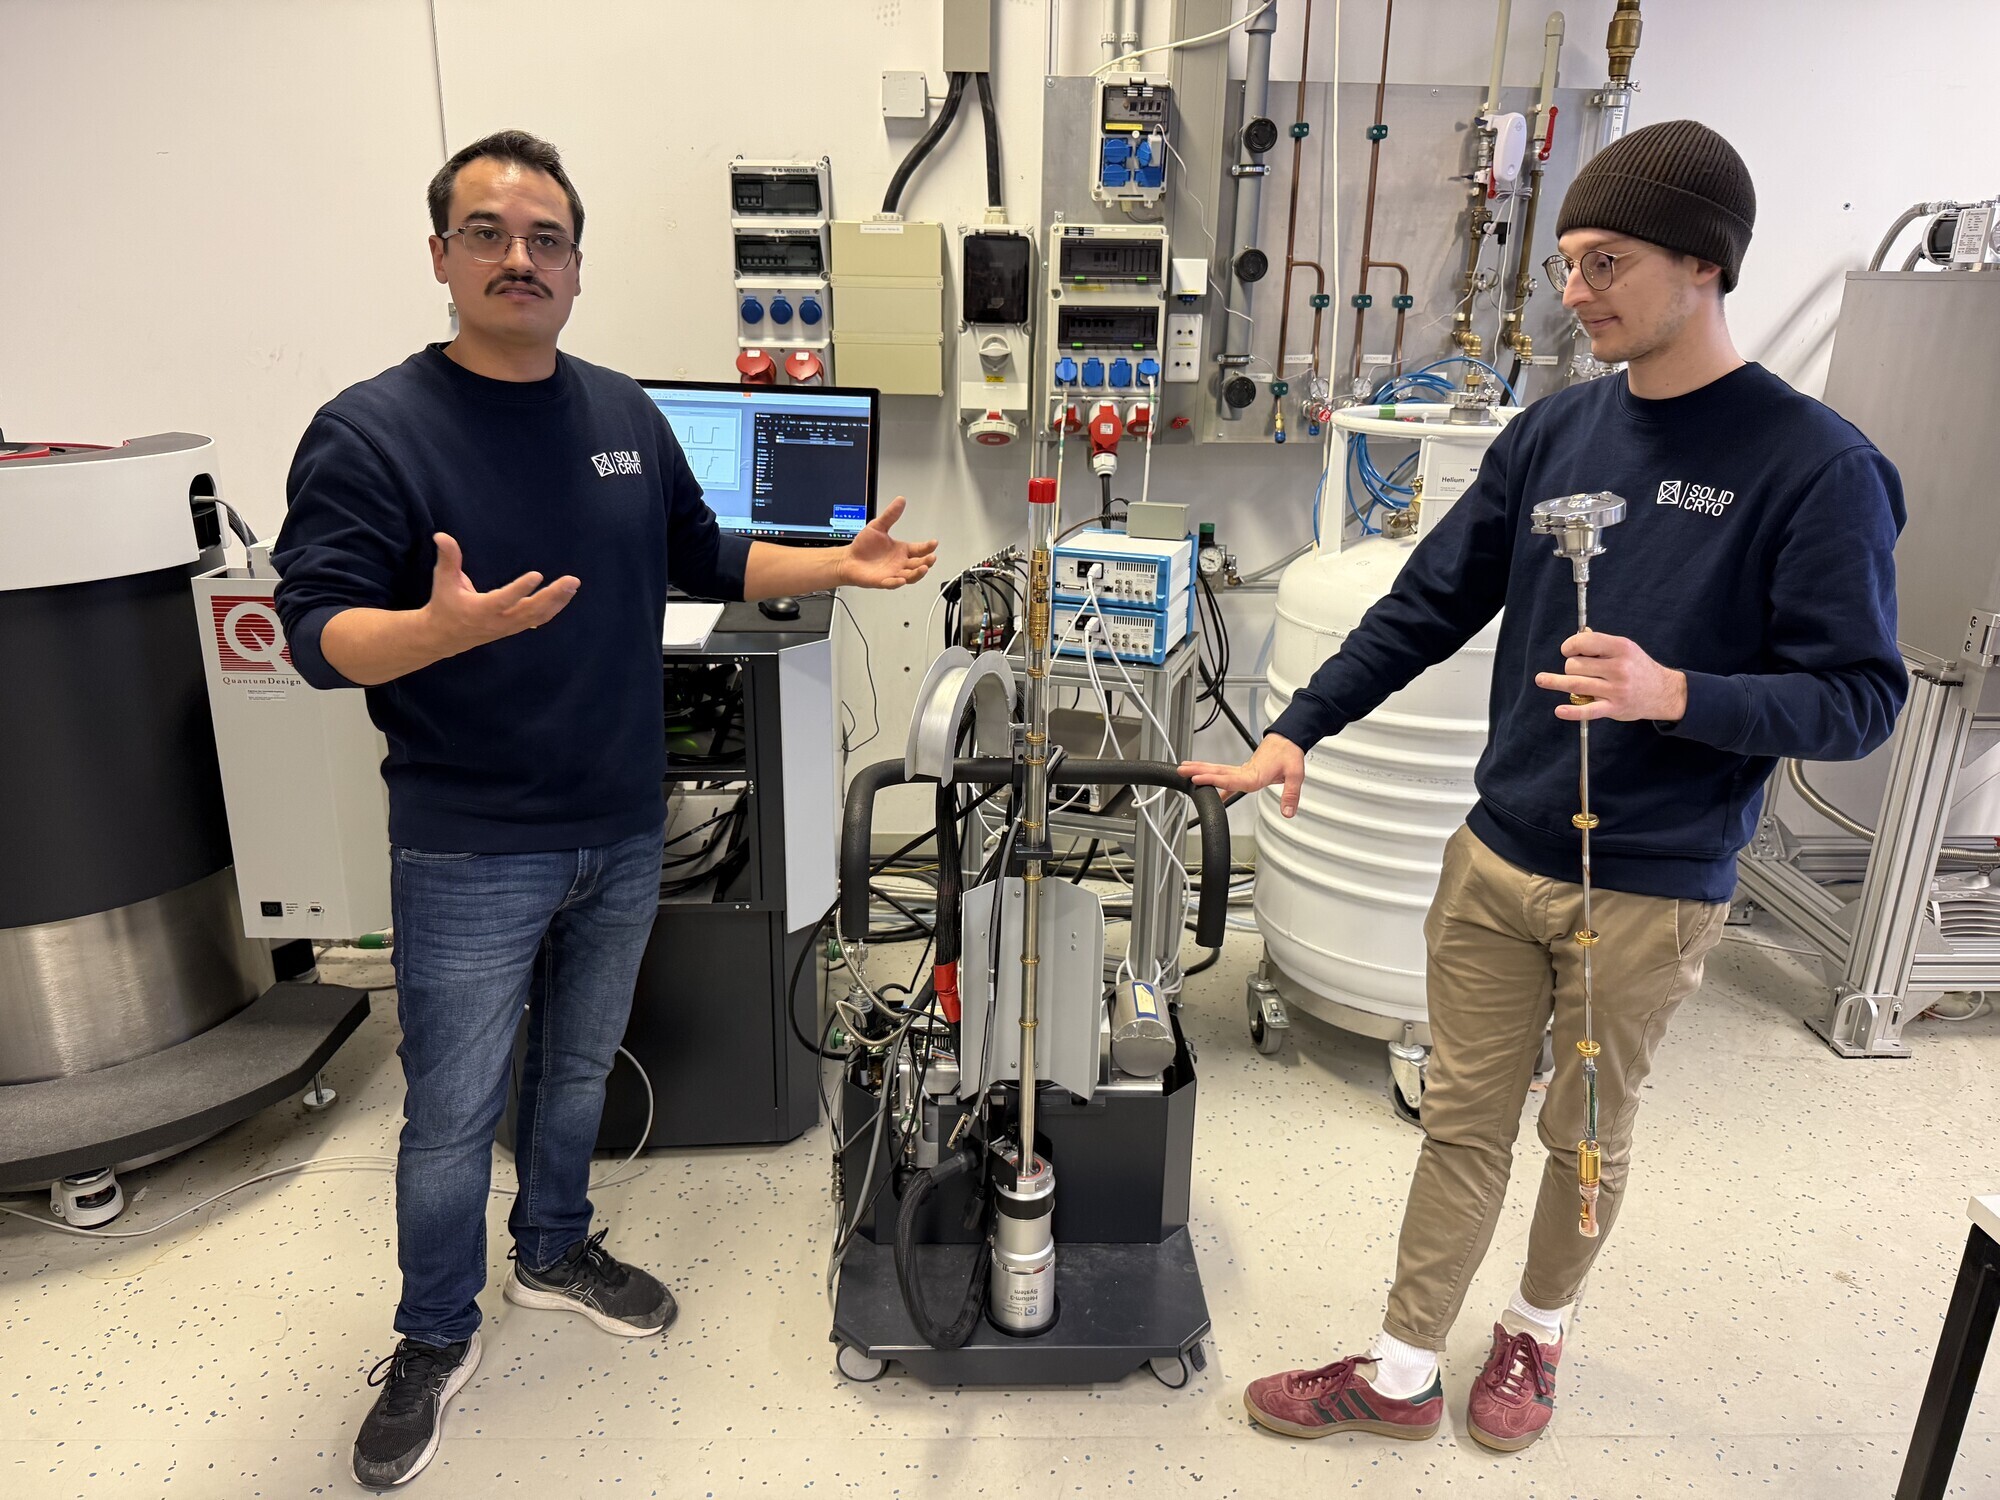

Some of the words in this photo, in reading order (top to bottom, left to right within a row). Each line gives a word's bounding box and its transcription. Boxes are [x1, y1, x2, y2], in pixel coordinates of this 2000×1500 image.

[614, 451, 640, 463] SOLID
[618, 462, 642, 474] CRYO
[1689, 484, 1735, 505] SOLID
[1683, 497, 1724, 517] CRYO
